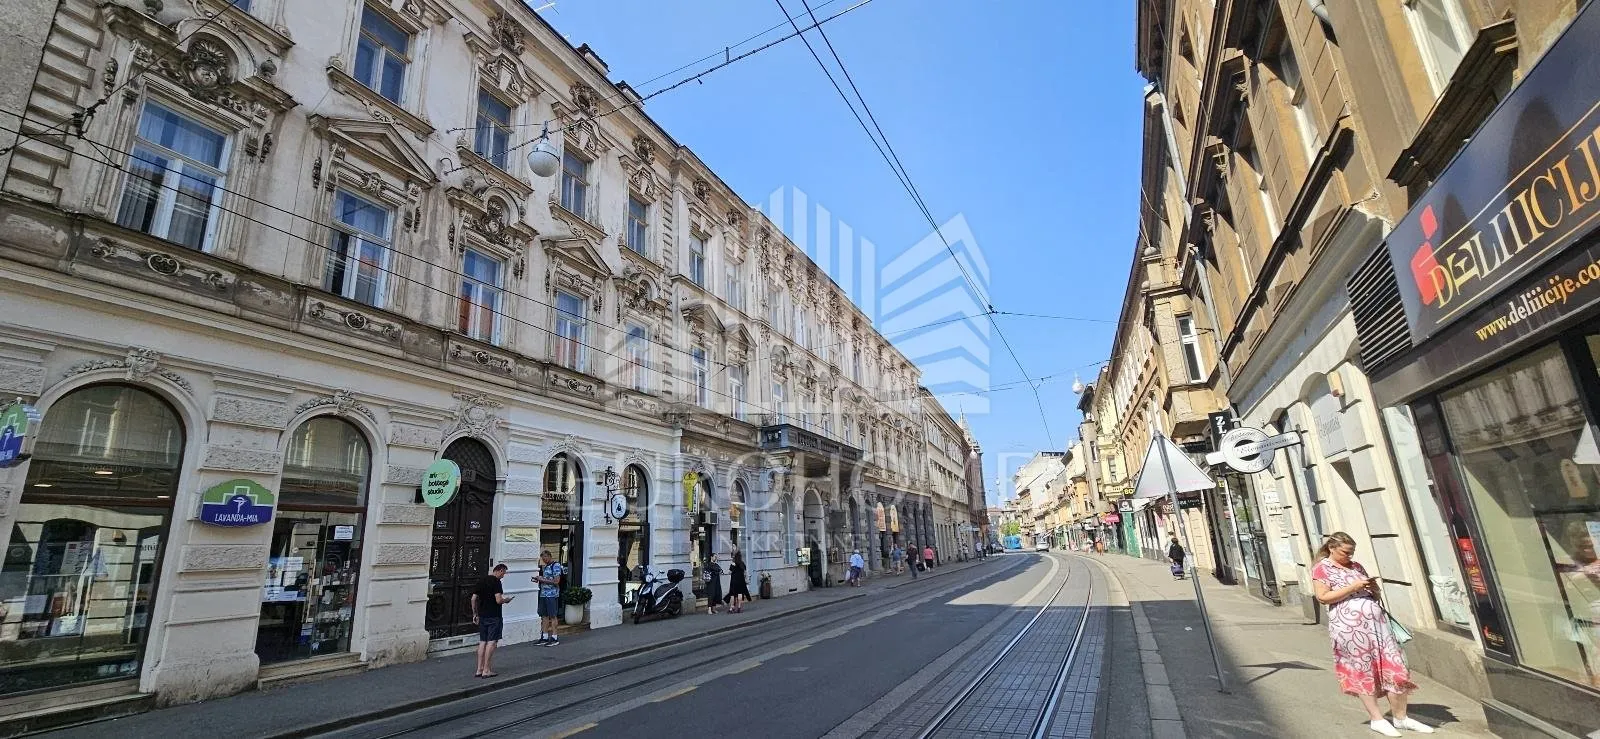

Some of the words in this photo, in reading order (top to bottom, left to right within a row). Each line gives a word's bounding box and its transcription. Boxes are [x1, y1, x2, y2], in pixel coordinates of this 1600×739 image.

[1475, 258, 1600, 342] www.deliiicije.co
[427, 488, 444, 496] studio
[214, 513, 259, 523] LAVANDA-MIA
